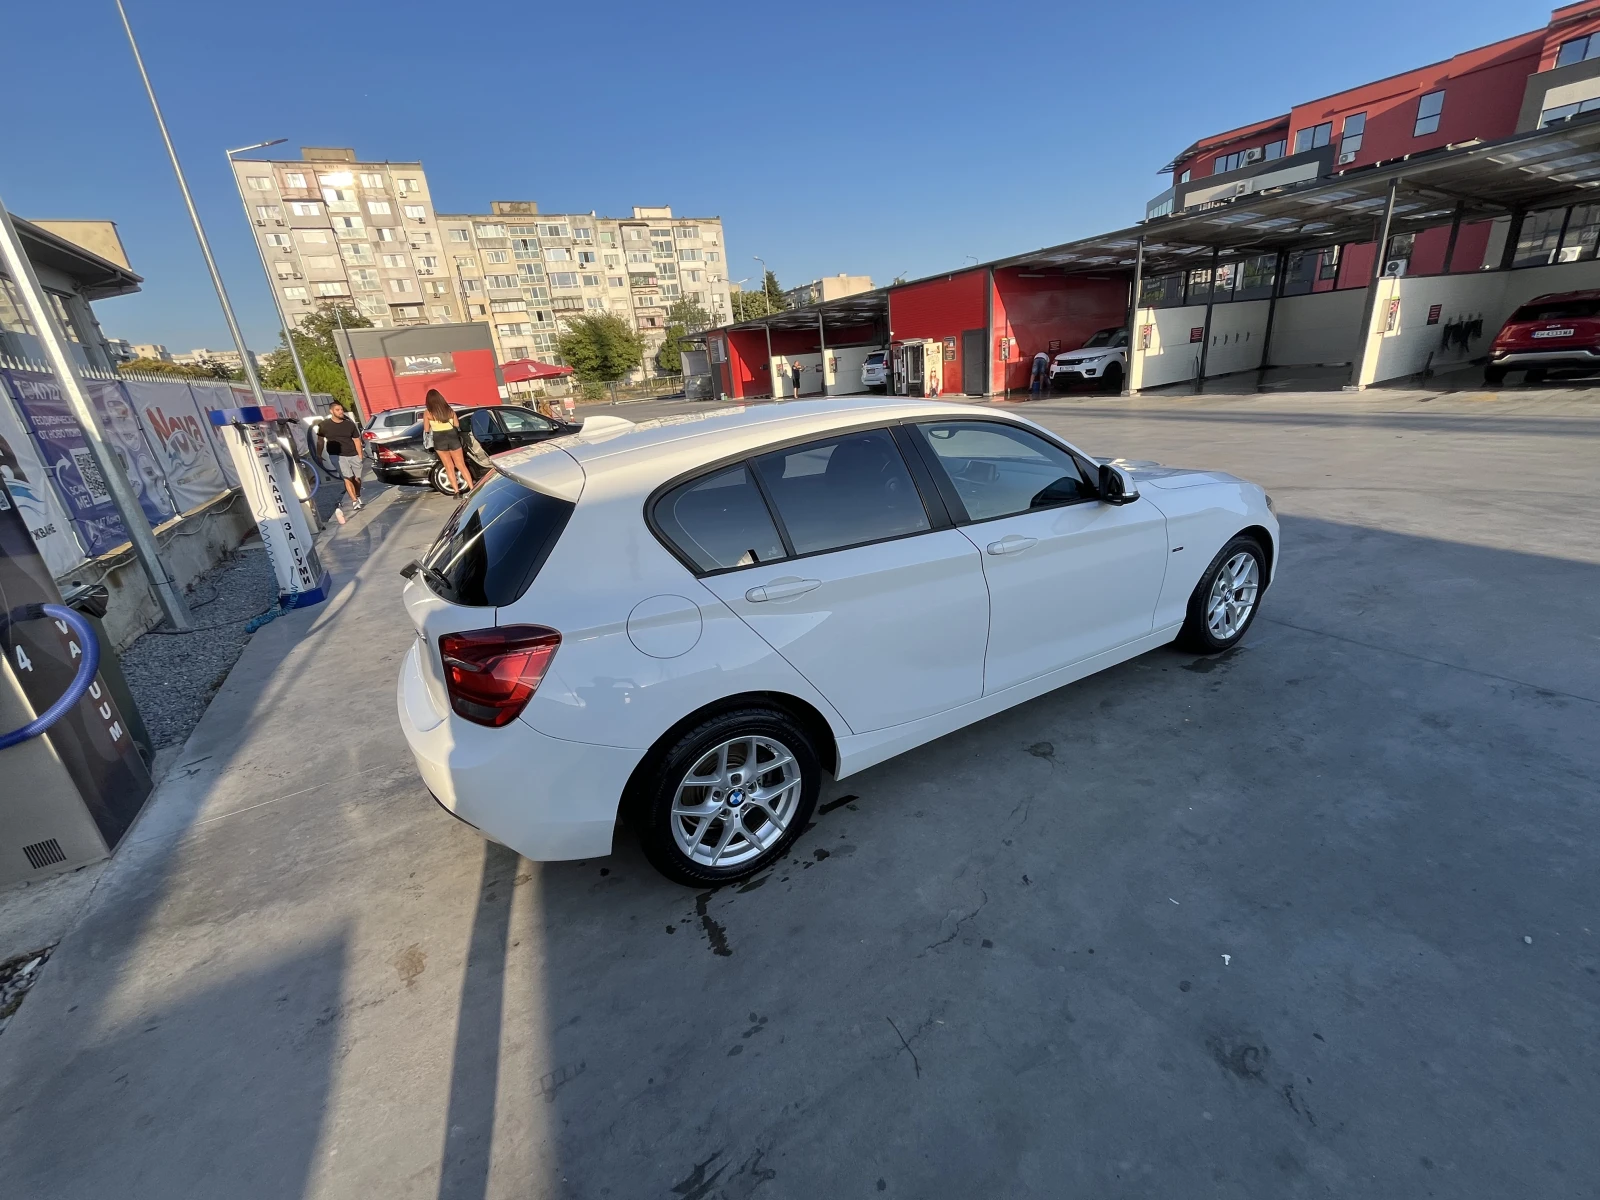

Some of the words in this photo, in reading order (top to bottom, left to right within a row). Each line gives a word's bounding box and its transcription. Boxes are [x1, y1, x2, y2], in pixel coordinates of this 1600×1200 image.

[404, 356, 443, 367] Nova
[146, 406, 206, 453] Nova
[69, 484, 89, 496] SCAN
[75, 495, 93, 510] ME!
[264, 464, 288, 515] ГЛАНЦ
[284, 522, 296, 541] ЗА
[293, 548, 311, 586] ГУМИ
[16, 644, 34, 672] 4
[55, 619, 123, 742] VAUUM
